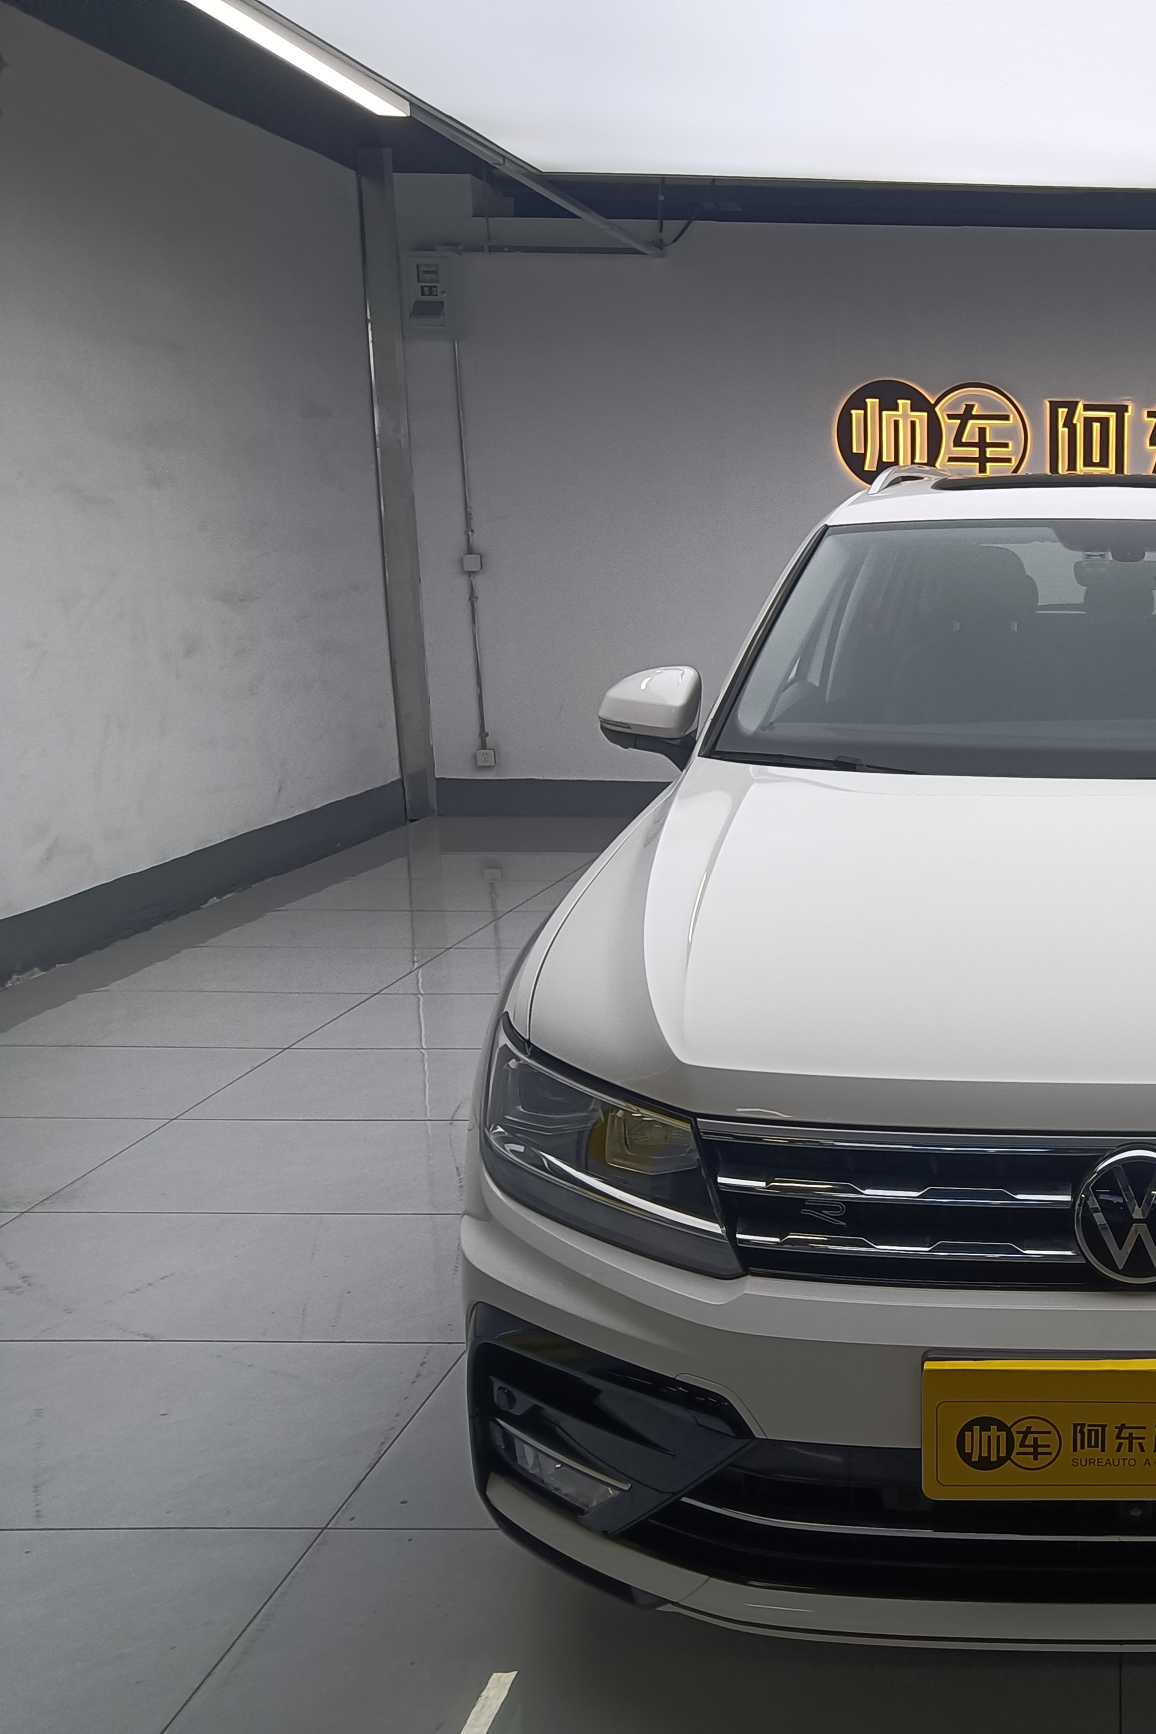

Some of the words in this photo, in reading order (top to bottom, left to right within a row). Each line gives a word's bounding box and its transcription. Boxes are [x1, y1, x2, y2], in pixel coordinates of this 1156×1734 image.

[849, 397, 1014, 476] 帅车
[964, 1423, 1052, 1463] 帅车
[1071, 1457, 1137, 1468] SUREAUTO
